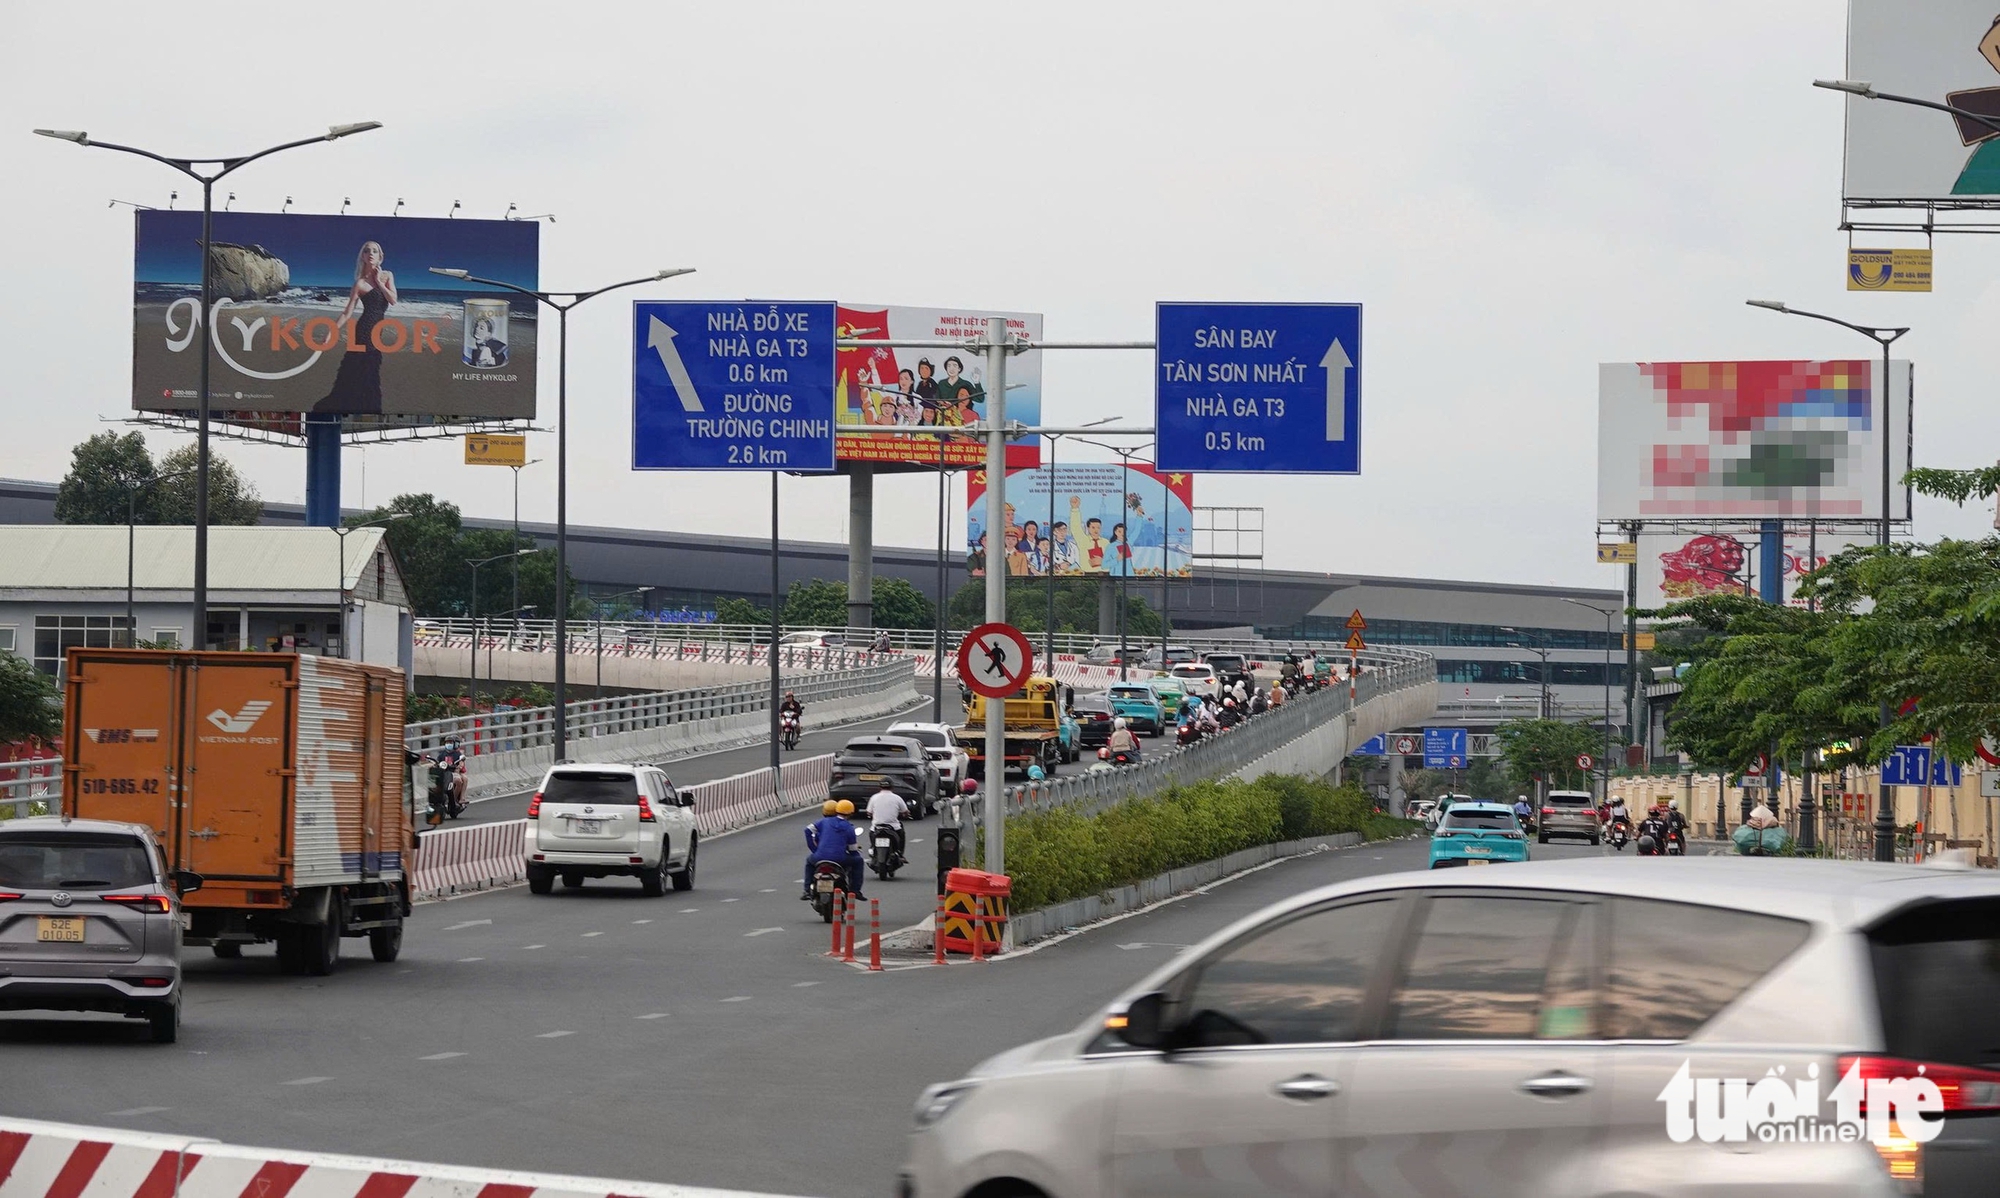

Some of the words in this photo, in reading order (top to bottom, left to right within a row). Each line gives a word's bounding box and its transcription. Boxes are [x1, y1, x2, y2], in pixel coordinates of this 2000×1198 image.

[1850, 255, 1892, 263] GOLDSUN
[707, 307, 748, 331] NHÀ
[754, 305, 779, 331] ĐỖ
[784, 312, 809, 332] XE
[940, 316, 962, 326] NHIỆT
[963, 316, 979, 327] LIỆT
[709, 334, 750, 357] NHÀ
[756, 338, 782, 357] GA
[786, 338, 808, 357] T3
[1194, 325, 1234, 348] SÂN
[1240, 330, 1277, 348] BAY
[465, 373, 481, 381] LIFE
[482, 374, 518, 382] MYKOLOR
[729, 364, 754, 382] 0.6
[760, 364, 788, 382] km
[1162, 359, 1202, 382] TÂN
[1207, 362, 1247, 382] SƠN
[1254, 356, 1307, 383] NHẤT
[724, 388, 792, 413] ĐƯỜNG
[1186, 392, 1228, 417] NHÀ
[1233, 398, 1259, 417] GA
[1263, 398, 1285, 417] T3
[686, 414, 764, 438] TRƯỜNG
[769, 419, 829, 438] CHINH
[1205, 432, 1231, 450] 0.5
[1237, 432, 1265, 450] km
[728, 445, 754, 464] 2.6
[759, 445, 787, 464] km
[98, 729, 132, 743] EMS
[198, 736, 247, 744] VIETNAM
[249, 736, 280, 745] POST
[51, 919, 71, 929] 62E
[42, 930, 79, 940] 010.05
